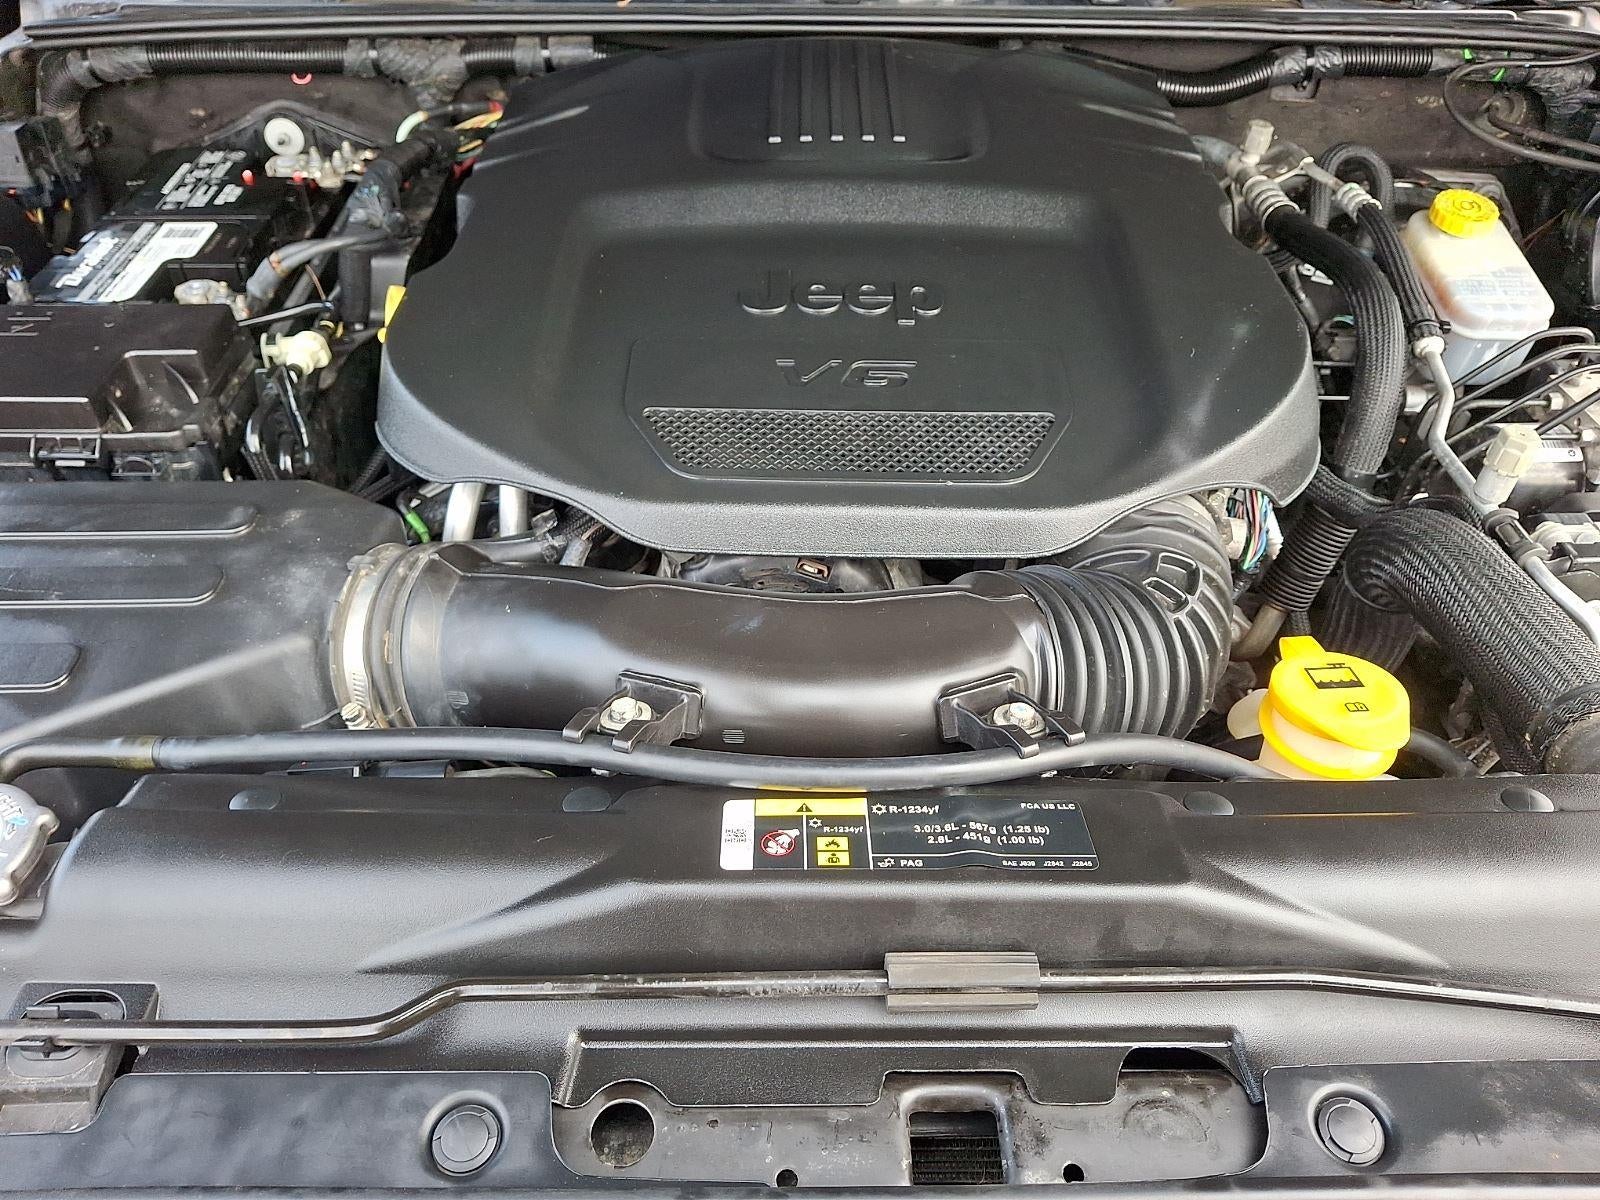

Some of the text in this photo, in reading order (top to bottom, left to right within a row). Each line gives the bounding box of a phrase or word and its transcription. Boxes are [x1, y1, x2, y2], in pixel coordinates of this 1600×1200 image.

[738, 269, 944, 326] Jeep
[776, 358, 918, 388] V6
[888, 804, 940, 815] R-1234yf
[823, 825, 864, 834] R-1234yf
[914, 822, 959, 833] 3.0/3.6L
[969, 821, 996, 835] 567g
[1003, 824, 1031, 835] (1.25
[1034, 825, 1050, 835] lb)
[962, 831, 991, 844] 451g
[997, 835, 1025, 846] (1.00
[1028, 836, 1045, 846] lb)
[900, 859, 923, 867] PAG
